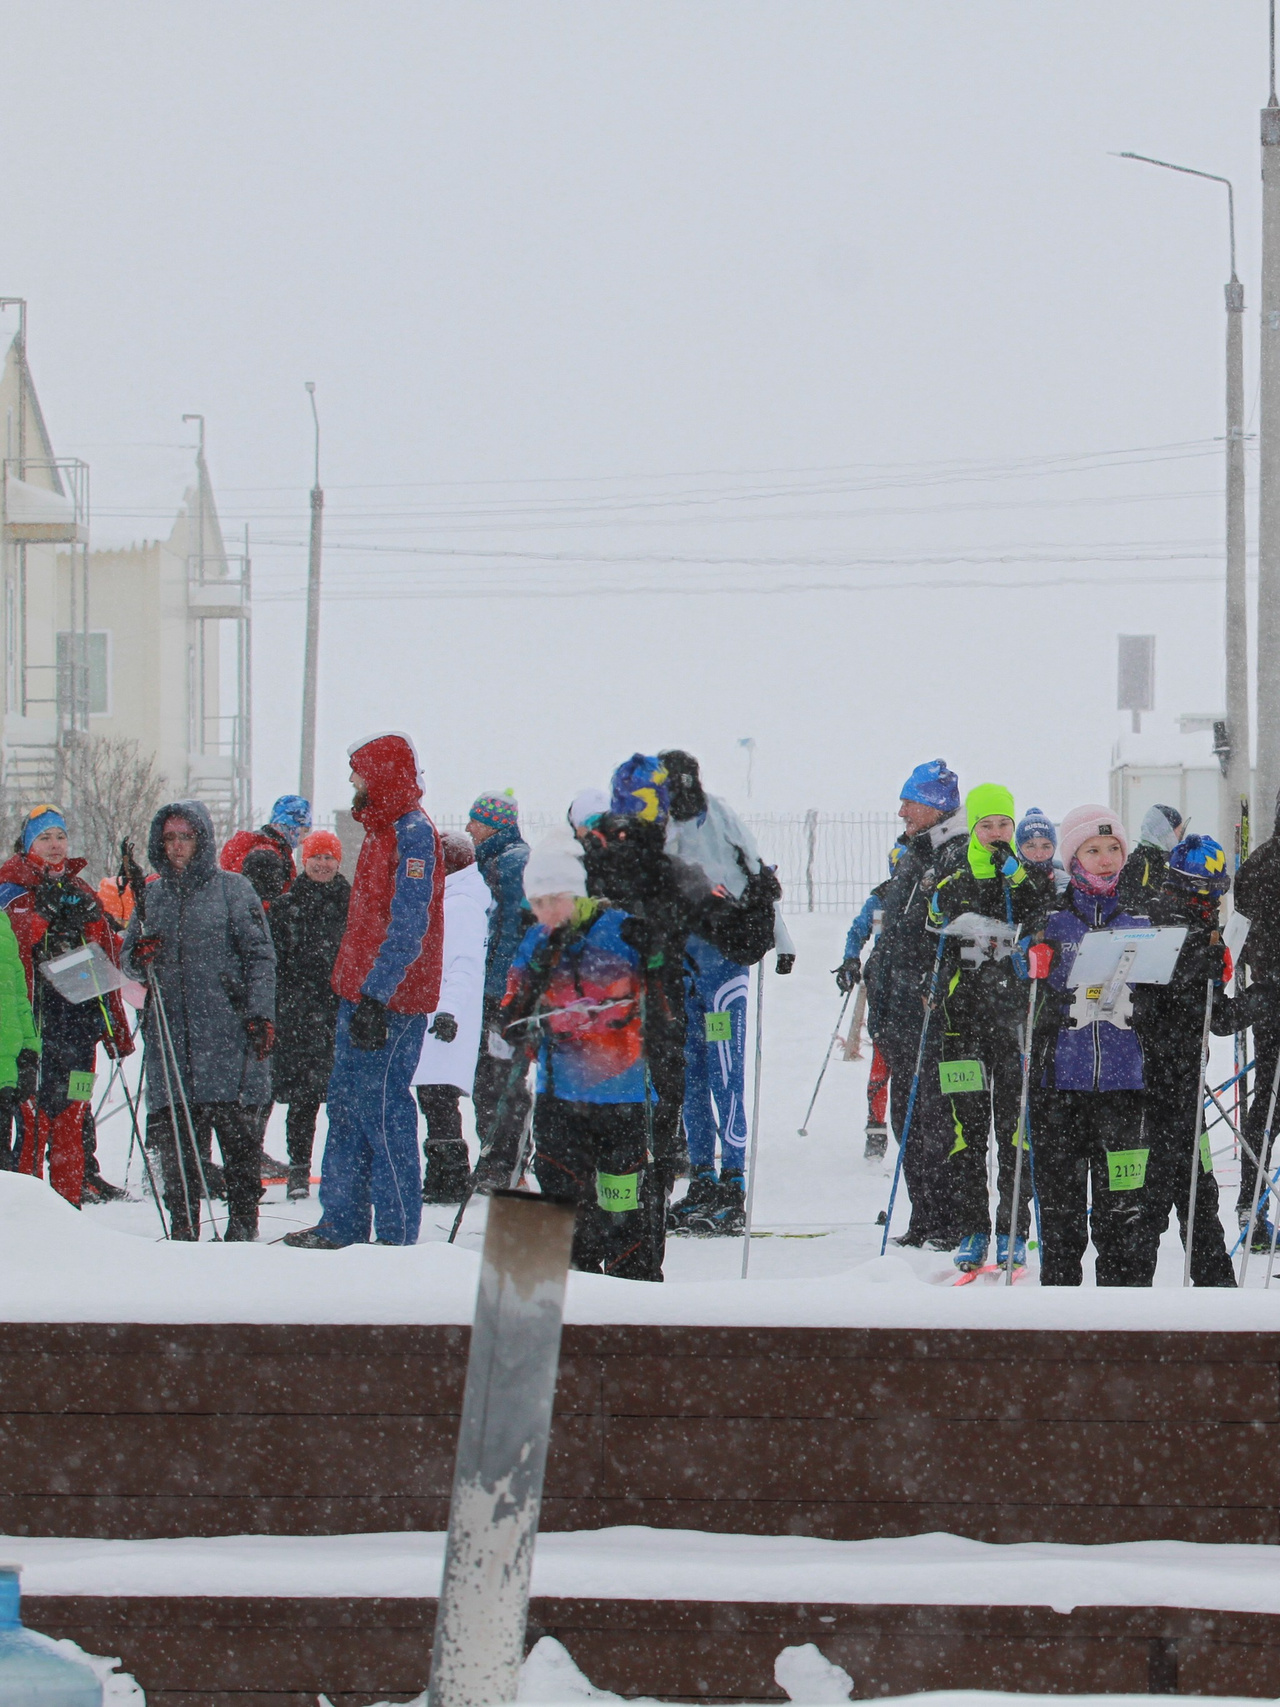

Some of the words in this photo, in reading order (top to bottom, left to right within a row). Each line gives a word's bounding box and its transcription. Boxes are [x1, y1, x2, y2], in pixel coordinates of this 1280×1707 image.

[1024, 822, 1049, 831] RUSSIA
[1061, 942, 1081, 952] RA
[946, 1071, 975, 1083] 120.2
